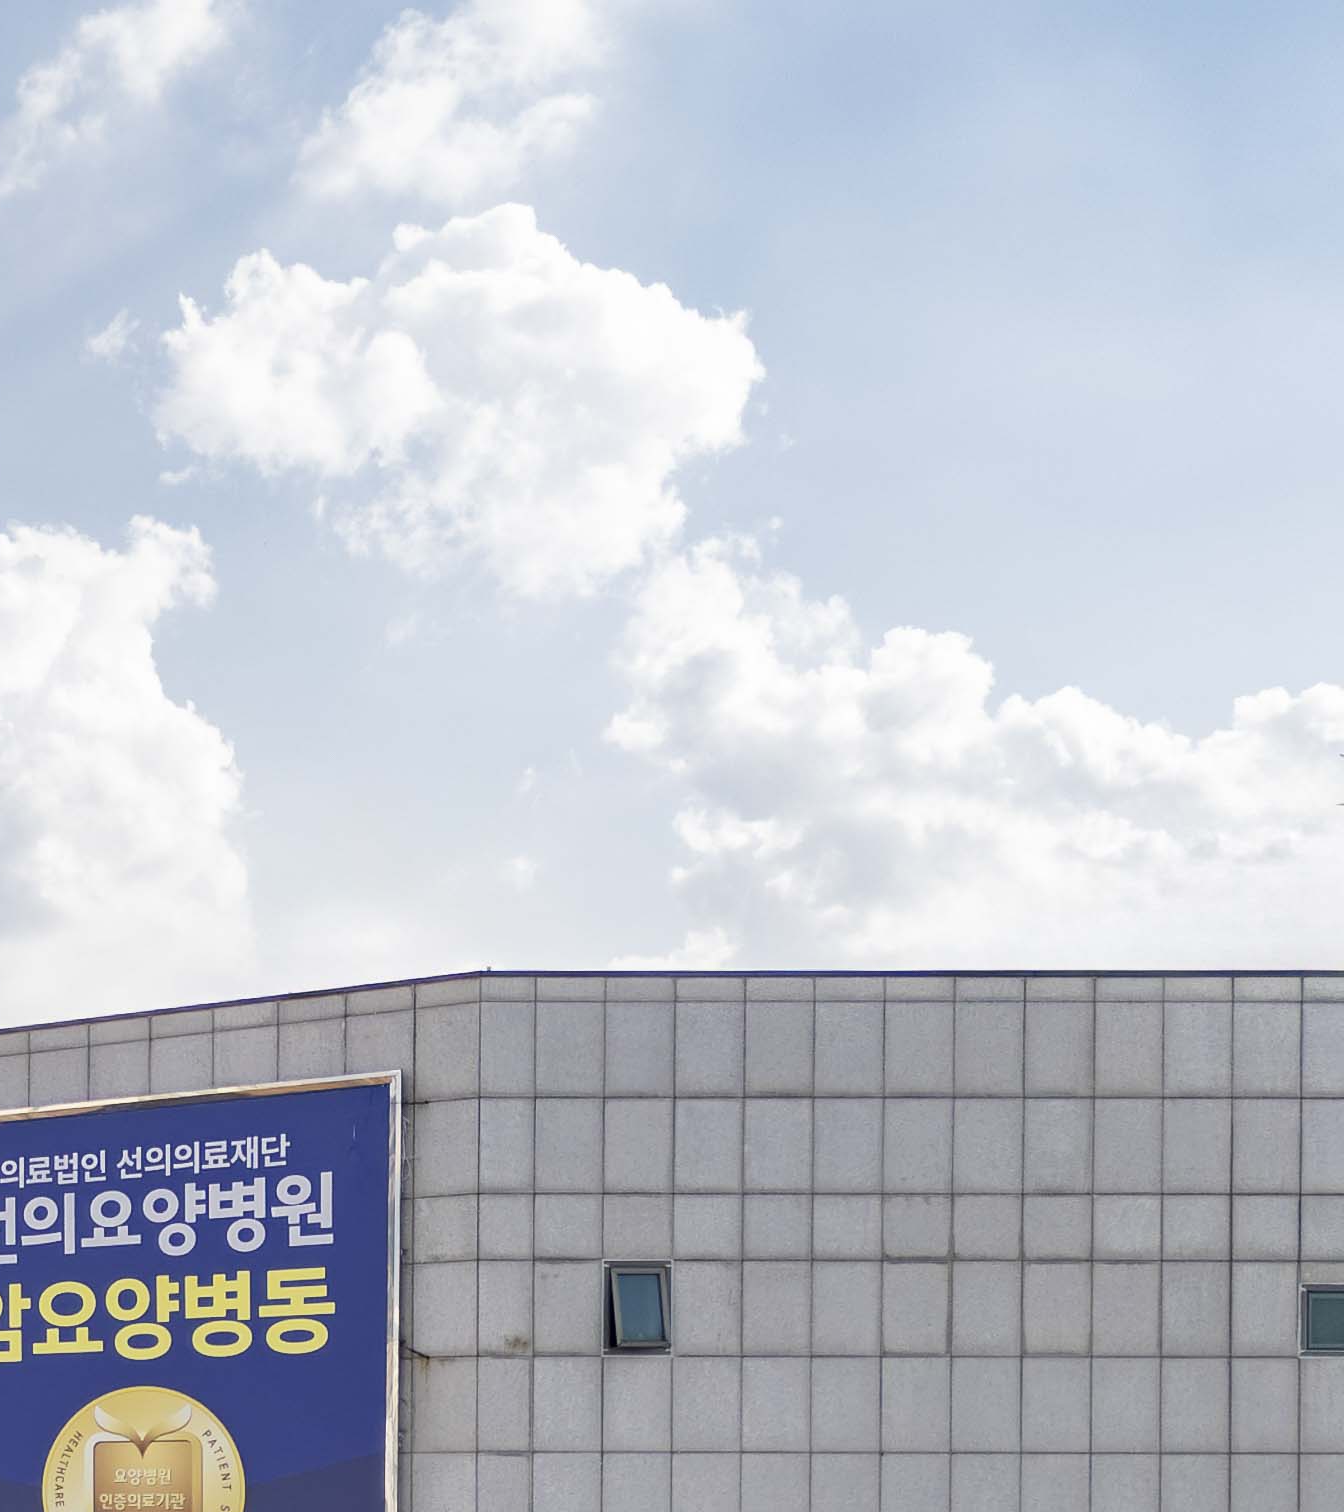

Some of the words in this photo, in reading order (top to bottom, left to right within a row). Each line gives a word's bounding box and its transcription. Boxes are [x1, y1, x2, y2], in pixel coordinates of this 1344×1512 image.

[0, 1150, 108, 1188] 의료법인
[116, 1133, 292, 1180] 선의의료재단
[53, 1431, 82, 1507] HEALTHCARE
[113, 1468, 173, 1484] 요양병원
[202, 1429, 233, 1491] PATIENT
[99, 1492, 186, 1511] 인증의료기관
